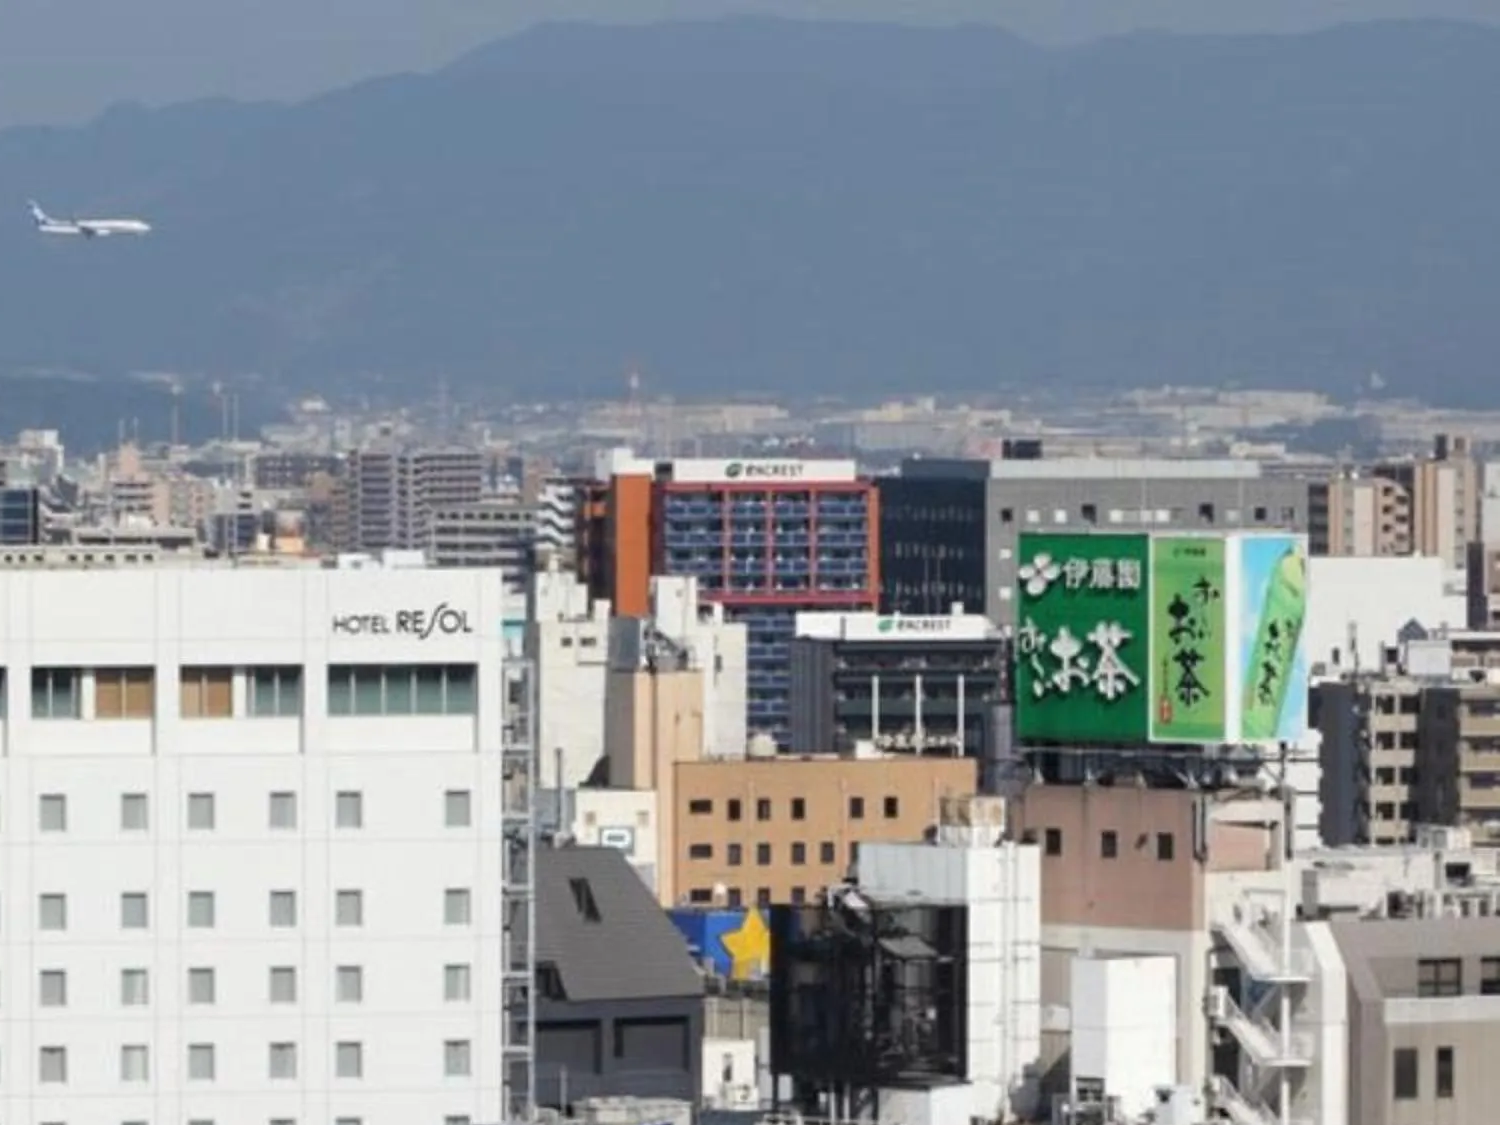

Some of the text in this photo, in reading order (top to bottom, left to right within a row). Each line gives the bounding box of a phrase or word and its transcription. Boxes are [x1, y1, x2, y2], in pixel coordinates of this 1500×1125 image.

[332, 602, 473, 640] HOTEL RESOL
[1050, 621, 1141, 700] お茶
